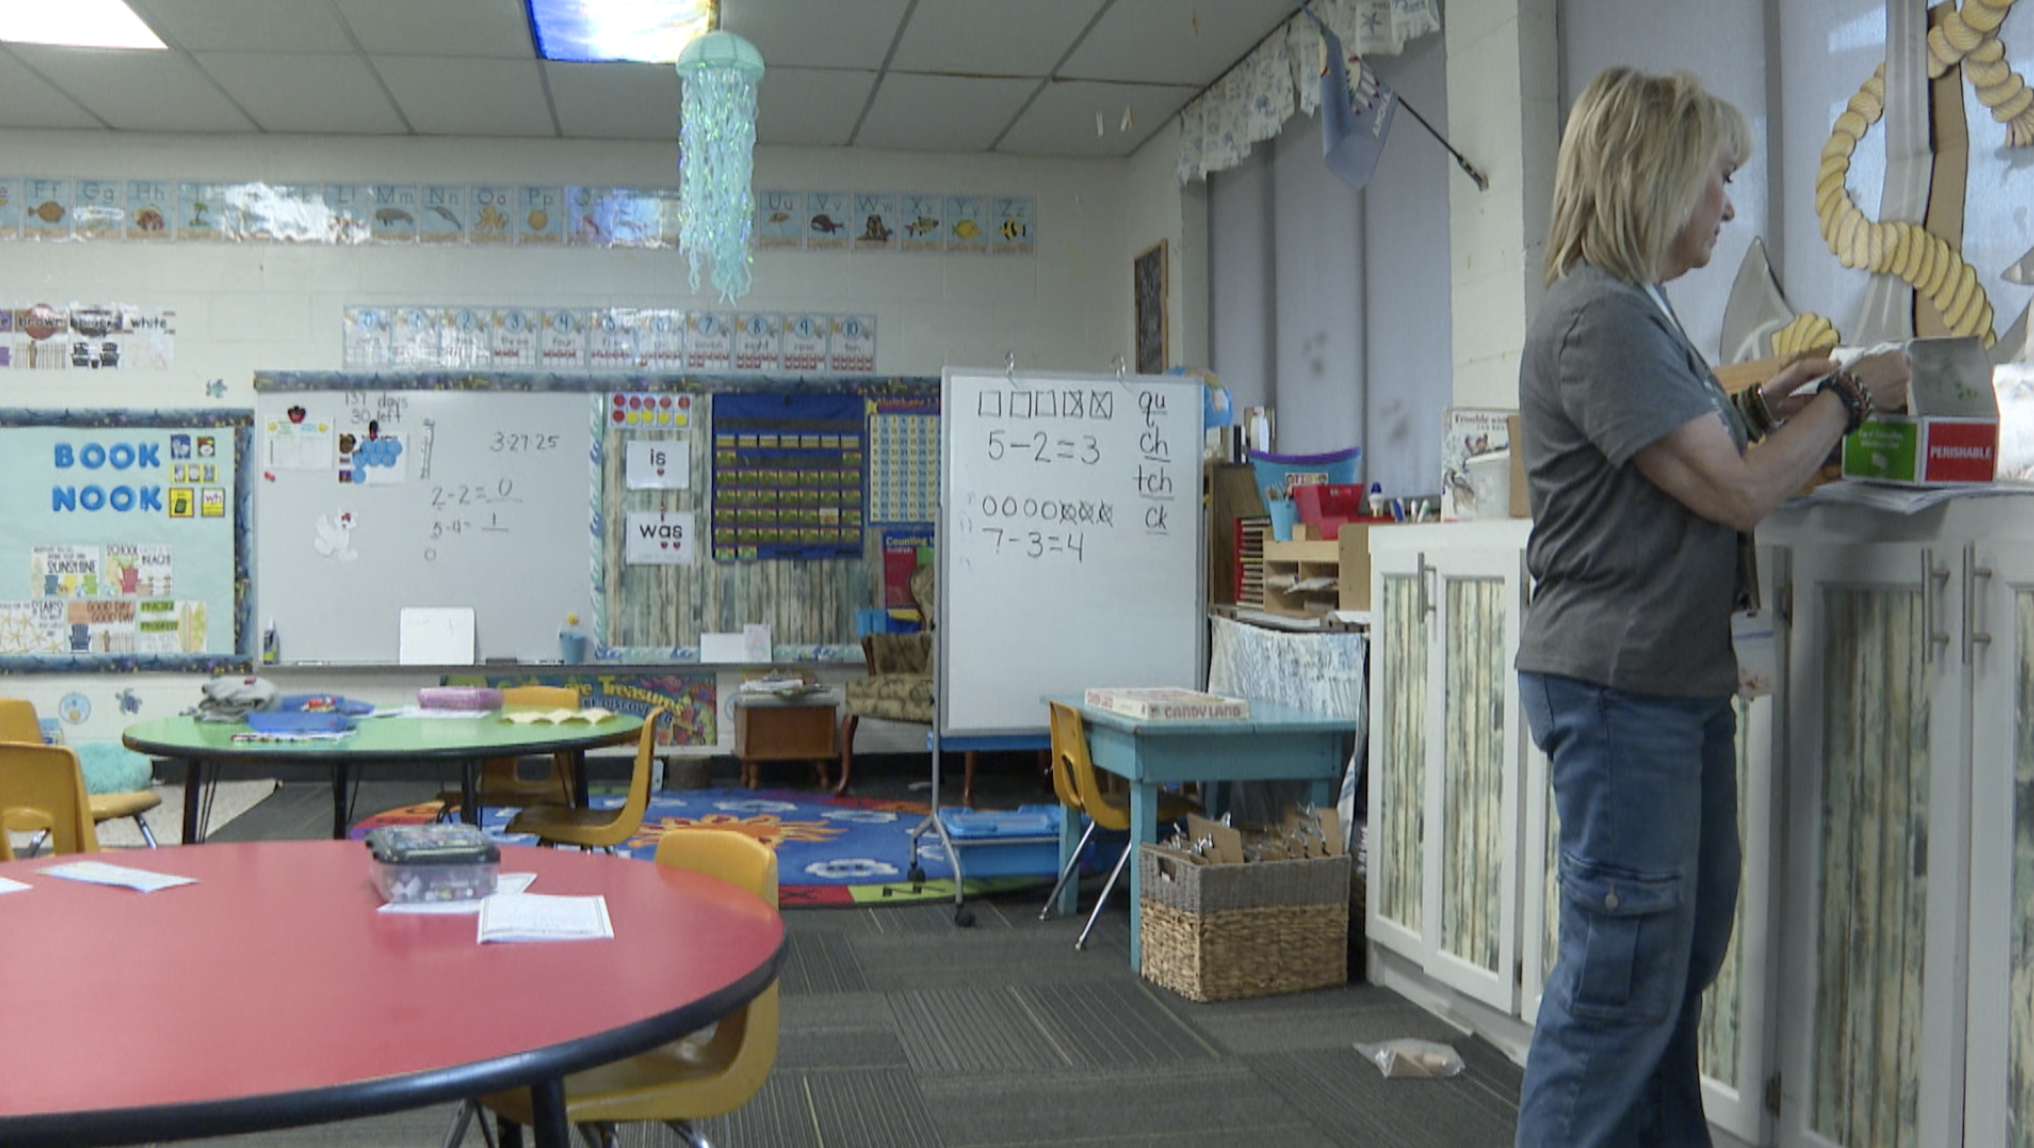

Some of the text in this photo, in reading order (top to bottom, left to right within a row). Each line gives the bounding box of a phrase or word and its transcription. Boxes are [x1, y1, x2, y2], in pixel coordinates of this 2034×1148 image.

[83, 184, 114, 205] Gg
[137, 183, 164, 200] Hh
[377, 186, 413, 204] Mm
[430, 186, 459, 204] Nn
[478, 187, 506, 205] Oo
[529, 188, 553, 211] Pp
[769, 194, 793, 211] Uu
[817, 194, 842, 212] Vv
[858, 195, 893, 213] Ww
[912, 196, 933, 215] Xx
[1001, 199, 1024, 218] Zz
[18, 315, 64, 329] brown
[130, 315, 167, 329] white
[511, 313, 520, 331] 3
[559, 314, 569, 331] 4
[705, 316, 714, 333] 7
[753, 318, 761, 334] 8
[800, 319, 808, 336] 9
[845, 320, 859, 336] 10
[377, 390, 408, 412] days
[1138, 391, 1167, 427] qu
[351, 407, 402, 425] 30 left
[1456, 414, 1488, 424] Trouble
[1139, 427, 1169, 456] ch
[1930, 445, 1993, 460] PERISHABLE
[54, 442, 161, 469] BOOK
[650, 448, 667, 466] is
[1133, 464, 1173, 494] tch
[52, 484, 162, 511] NOOK
[639, 523, 683, 539] was
[886, 537, 927, 547] Counting
[598, 675, 684, 715] Treasures
[1165, 703, 1241, 719] CANDY LAND
